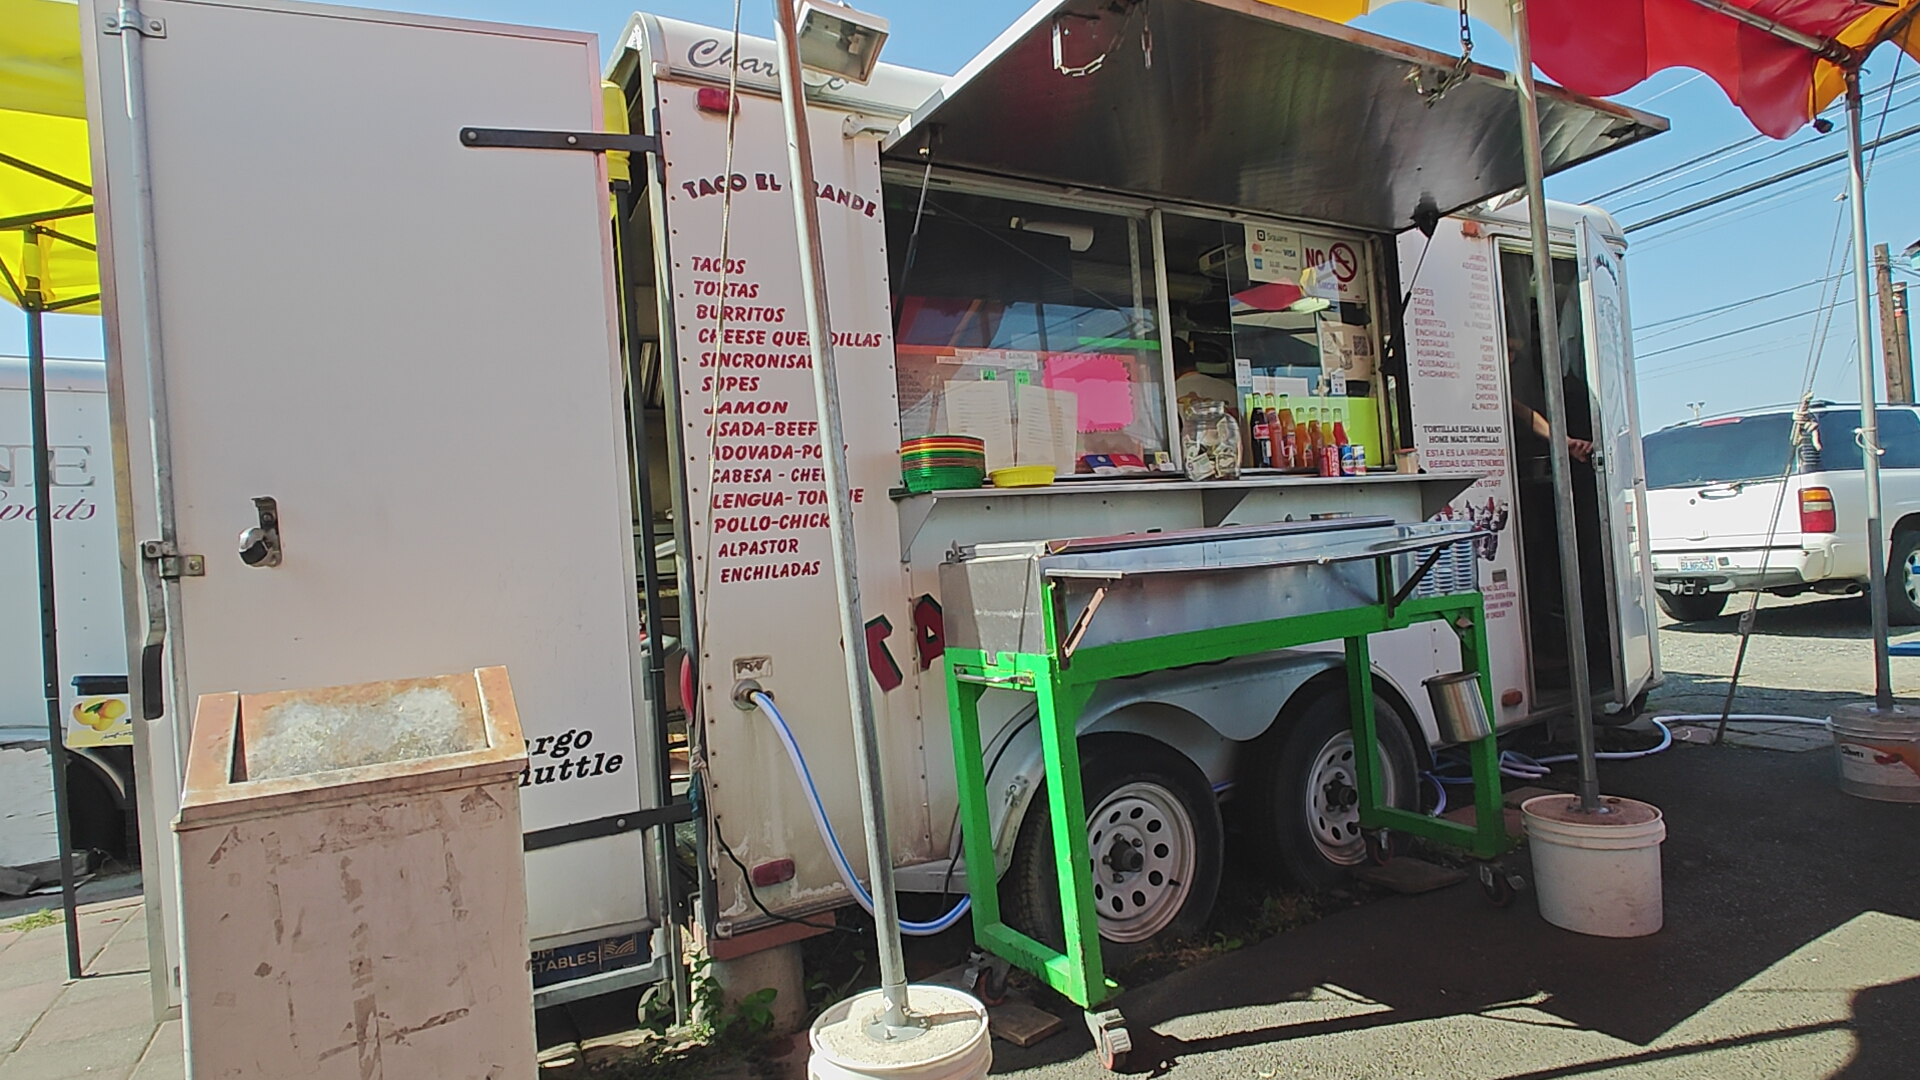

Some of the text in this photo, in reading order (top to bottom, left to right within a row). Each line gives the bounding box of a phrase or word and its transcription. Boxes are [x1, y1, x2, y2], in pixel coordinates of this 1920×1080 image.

[688, 39, 848, 90] Charc
[682, 173, 877, 218] TACO EL ANDE
[691, 256, 746, 274] TACOS
[1305, 247, 1325, 271] NO
[693, 280, 759, 299] TORTAS
[1318, 281, 1348, 292] SMOKING
[696, 304, 786, 323] BURRITOS
[698, 329, 882, 348] CHEESE QUESDILLAS
[703, 401, 789, 414] JAMON
[709, 444, 848, 461] ADOVADA-PO
[1426, 449, 1445, 457] ESTA
[1446, 449, 1455, 457] ES
[712, 468, 771, 483] CABESA
[798, 488, 864, 505] TONE
[714, 513, 853, 534] POLLO-CHICK
[718, 539, 799, 558] ALPASTOR
[720, 561, 821, 583] ENCHILADAS
[524, 730, 593, 758] rgo
